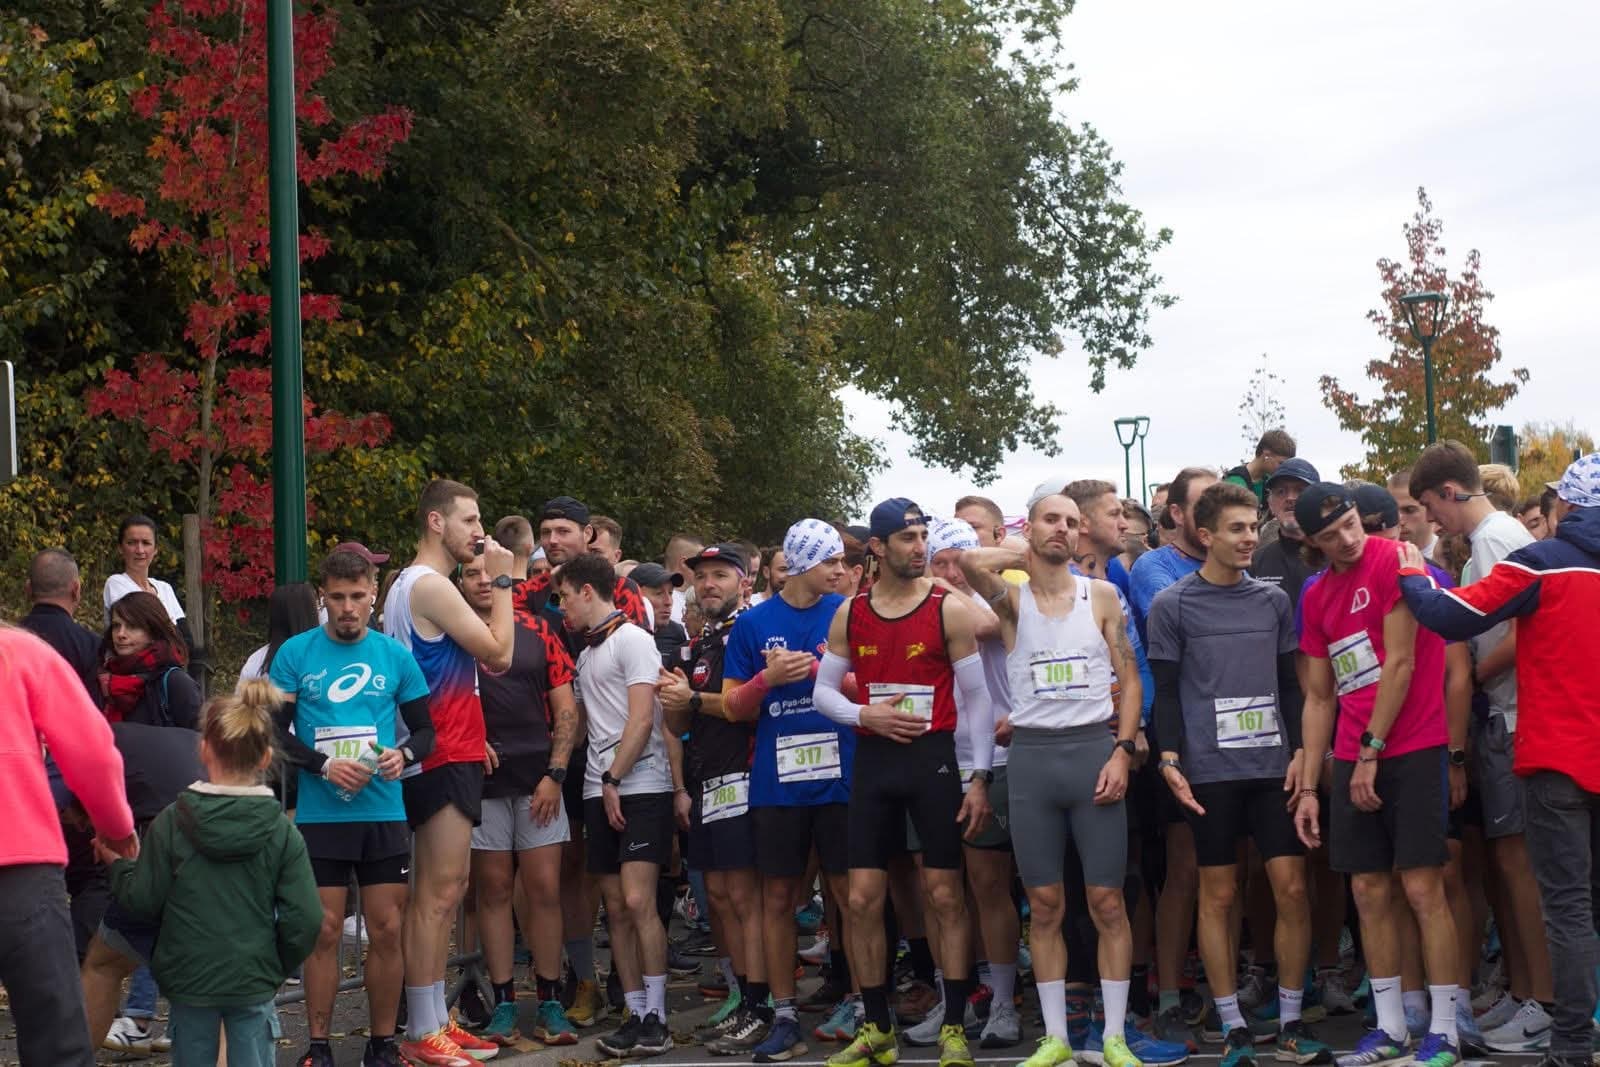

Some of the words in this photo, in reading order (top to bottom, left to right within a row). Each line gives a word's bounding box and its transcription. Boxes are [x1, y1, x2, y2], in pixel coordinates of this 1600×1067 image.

[1236, 710, 1264, 731] 167
[332, 740, 361, 759] 147
[795, 746, 822, 766] 317
[712, 785, 737, 807] 288
